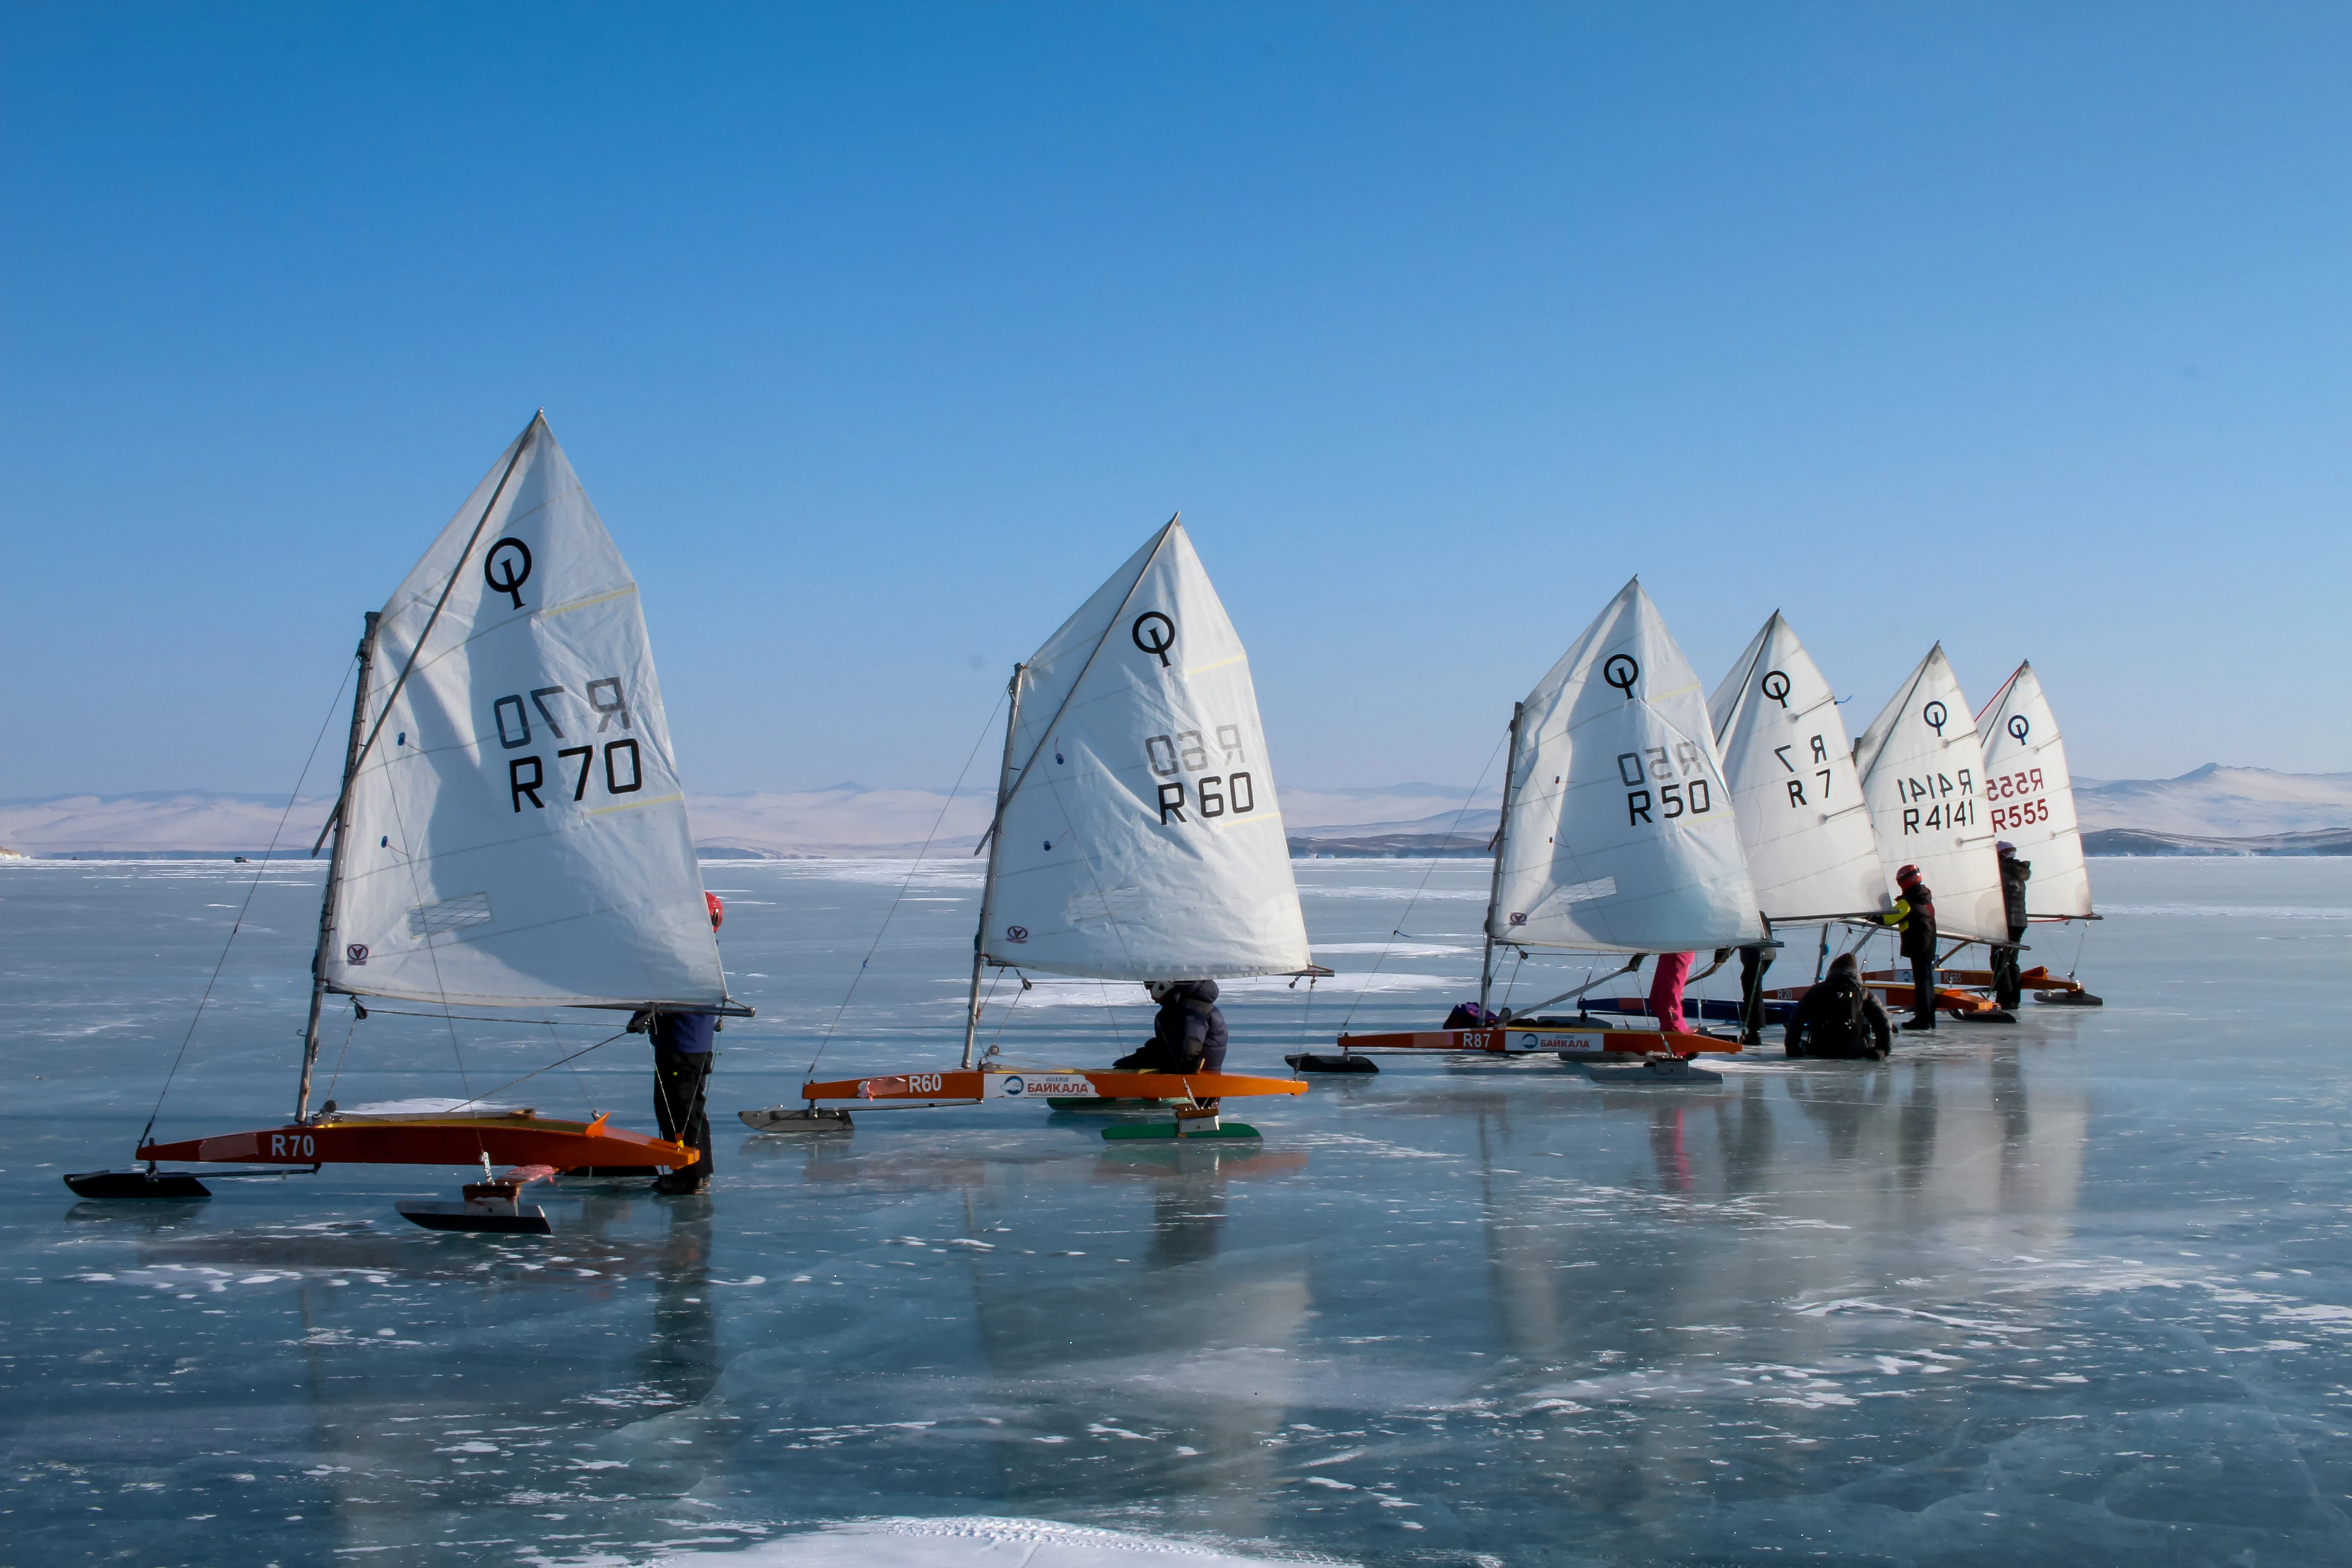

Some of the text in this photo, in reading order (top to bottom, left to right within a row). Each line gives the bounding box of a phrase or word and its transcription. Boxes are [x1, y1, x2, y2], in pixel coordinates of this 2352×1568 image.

[1991, 798, 2049, 833] R555
[1463, 1033, 1491, 1048] R87
[909, 1073, 942, 1093] R60
[1028, 1082, 1089, 1093] БАЙКАЛА
[272, 1134, 314, 1156] R70
